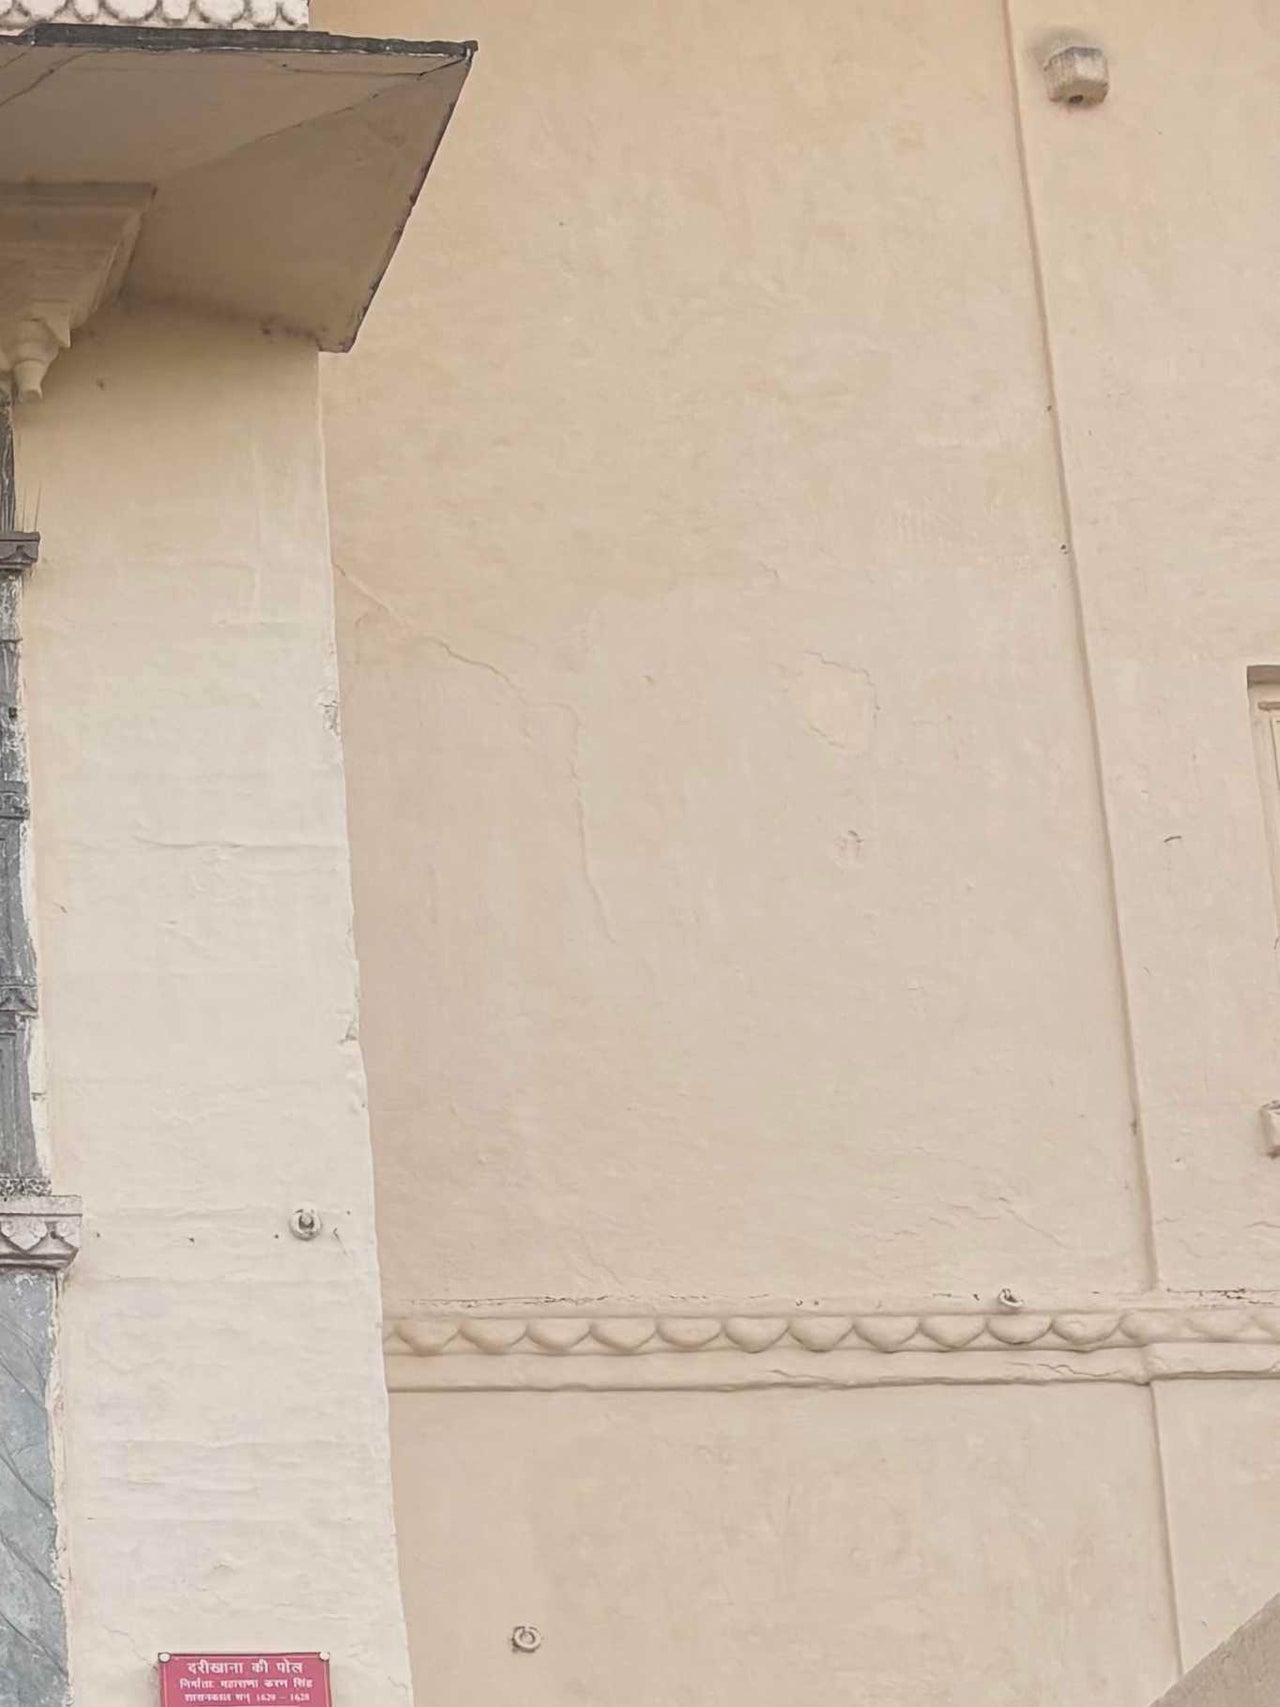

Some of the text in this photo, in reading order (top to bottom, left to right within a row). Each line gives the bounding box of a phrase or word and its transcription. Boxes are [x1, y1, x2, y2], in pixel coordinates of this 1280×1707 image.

[186, 1658, 303, 1674] दरीखाना की पोल
